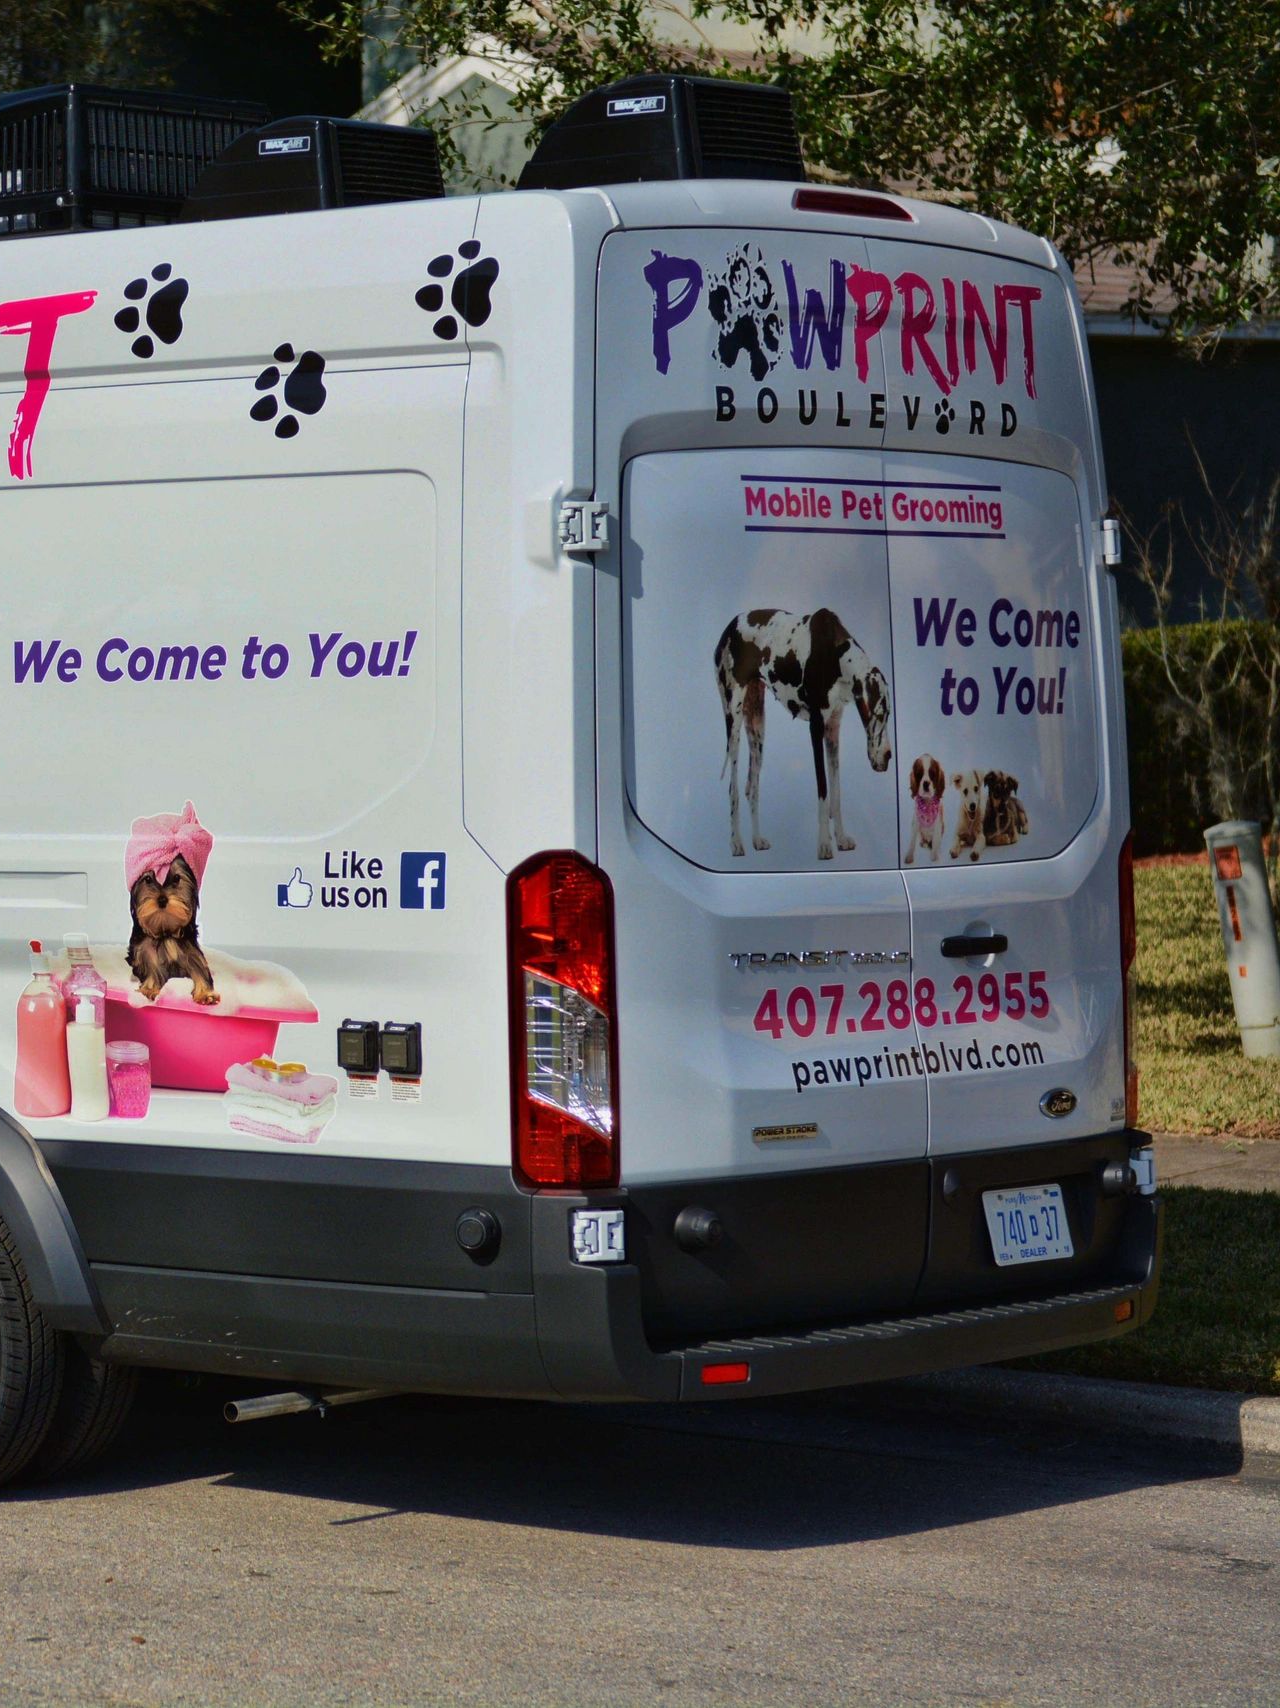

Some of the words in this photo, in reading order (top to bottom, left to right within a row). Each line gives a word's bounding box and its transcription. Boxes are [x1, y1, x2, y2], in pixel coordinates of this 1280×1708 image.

[715, 385, 1018, 438] BOULEVRD
[744, 485, 832, 519] Mobile
[841, 490, 885, 521] Pet
[891, 492, 1004, 531] Grooming
[912, 597, 978, 648] We
[988, 597, 1081, 649] Come
[13, 639, 82, 684] We
[95, 637, 227, 682] Come
[241, 636, 290, 680] to
[308, 630, 419, 678] You!
[940, 667, 980, 717] to
[991, 666, 1067, 716] You!
[323, 850, 384, 881] Like
[320, 884, 350, 909] us
[353, 884, 389, 909] on
[728, 950, 849, 968] TRANSIT
[753, 970, 1051, 1040] 407.288.2955
[791, 1036, 1046, 1093] pawprintblvd.com
[997, 1210, 1027, 1246] 740
[1041, 1206, 1059, 1240] 37
[1020, 1247, 1048, 1258] DEALER
